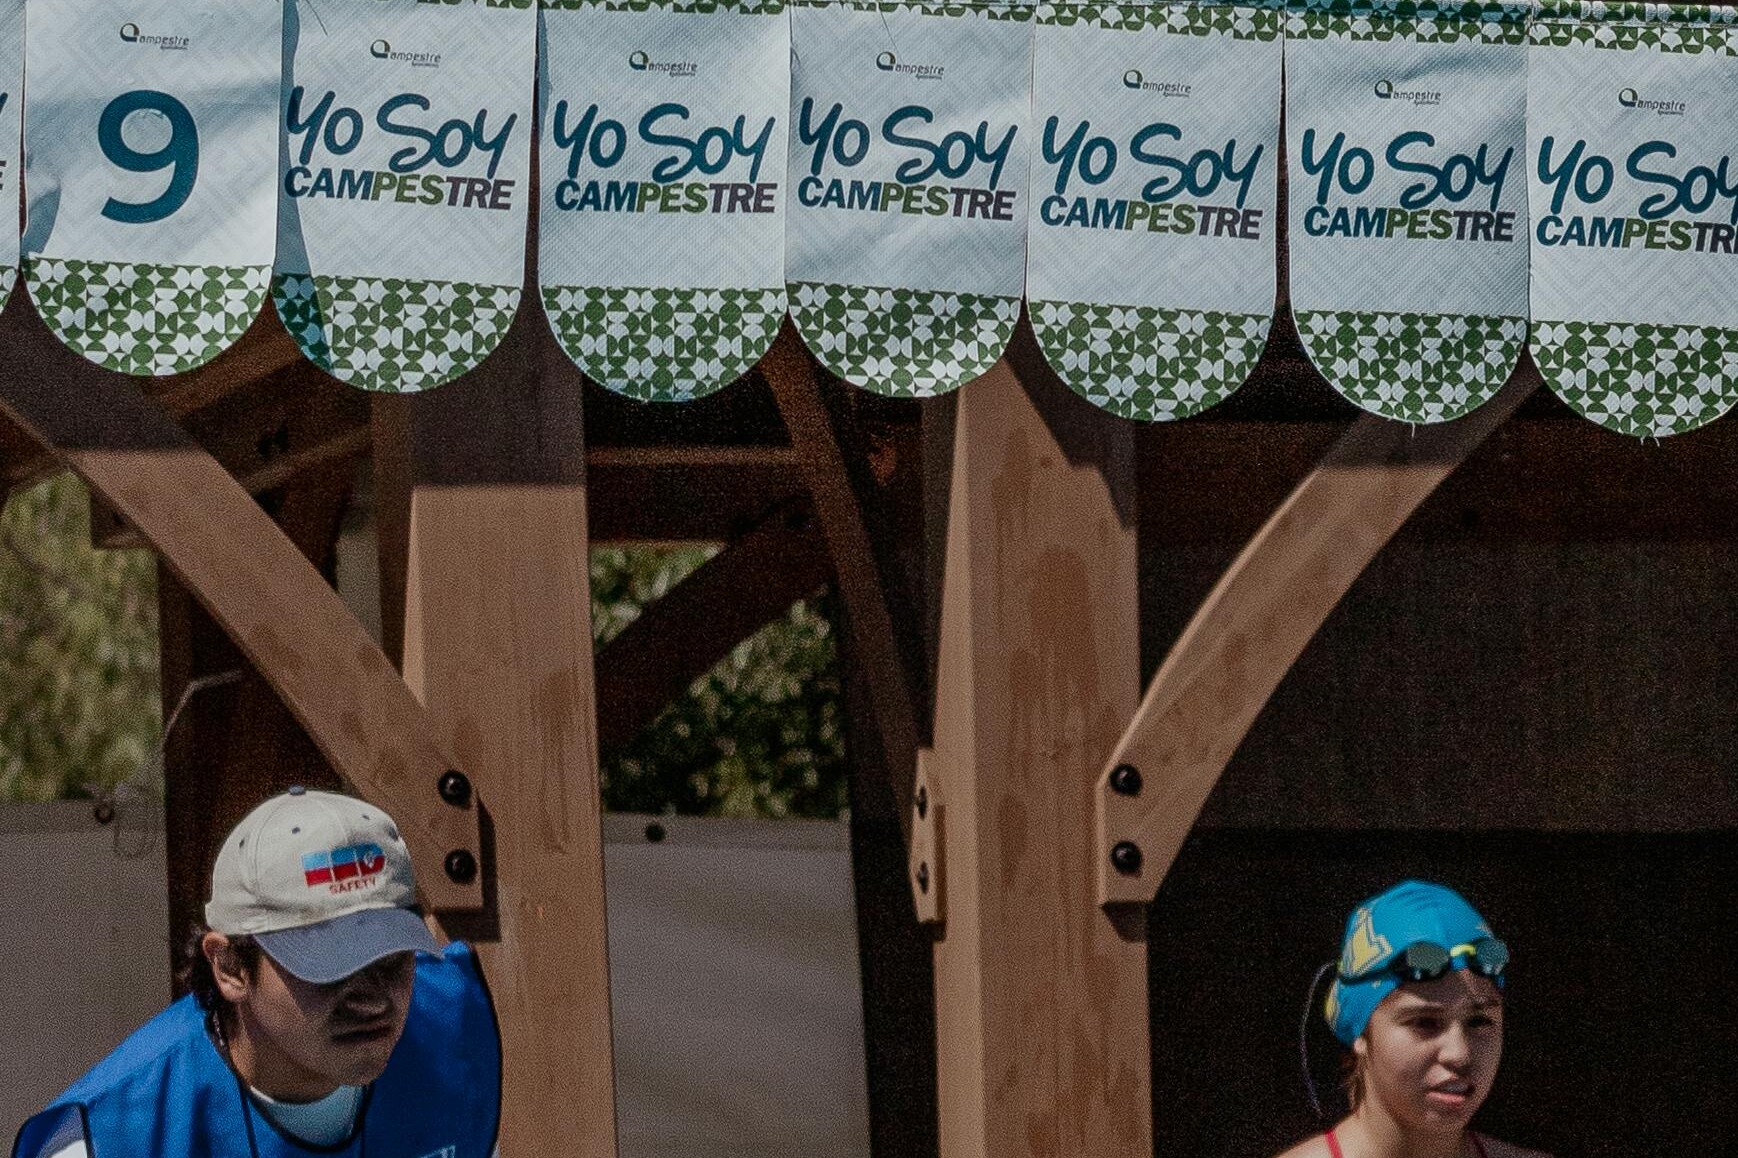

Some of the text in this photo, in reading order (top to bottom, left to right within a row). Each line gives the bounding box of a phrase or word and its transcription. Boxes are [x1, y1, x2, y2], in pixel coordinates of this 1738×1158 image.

[98, 90, 199, 224] 9
[284, 166, 515, 210] CAMPESTRE
[555, 179, 778, 213] CAMPESTRE
[798, 175, 1017, 221] CAMPESTRE
[1040, 195, 1264, 240] CAMPESTRE
[1304, 205, 1516, 242] CAMPESTRE
[329, 876, 376, 895] SAFETY
